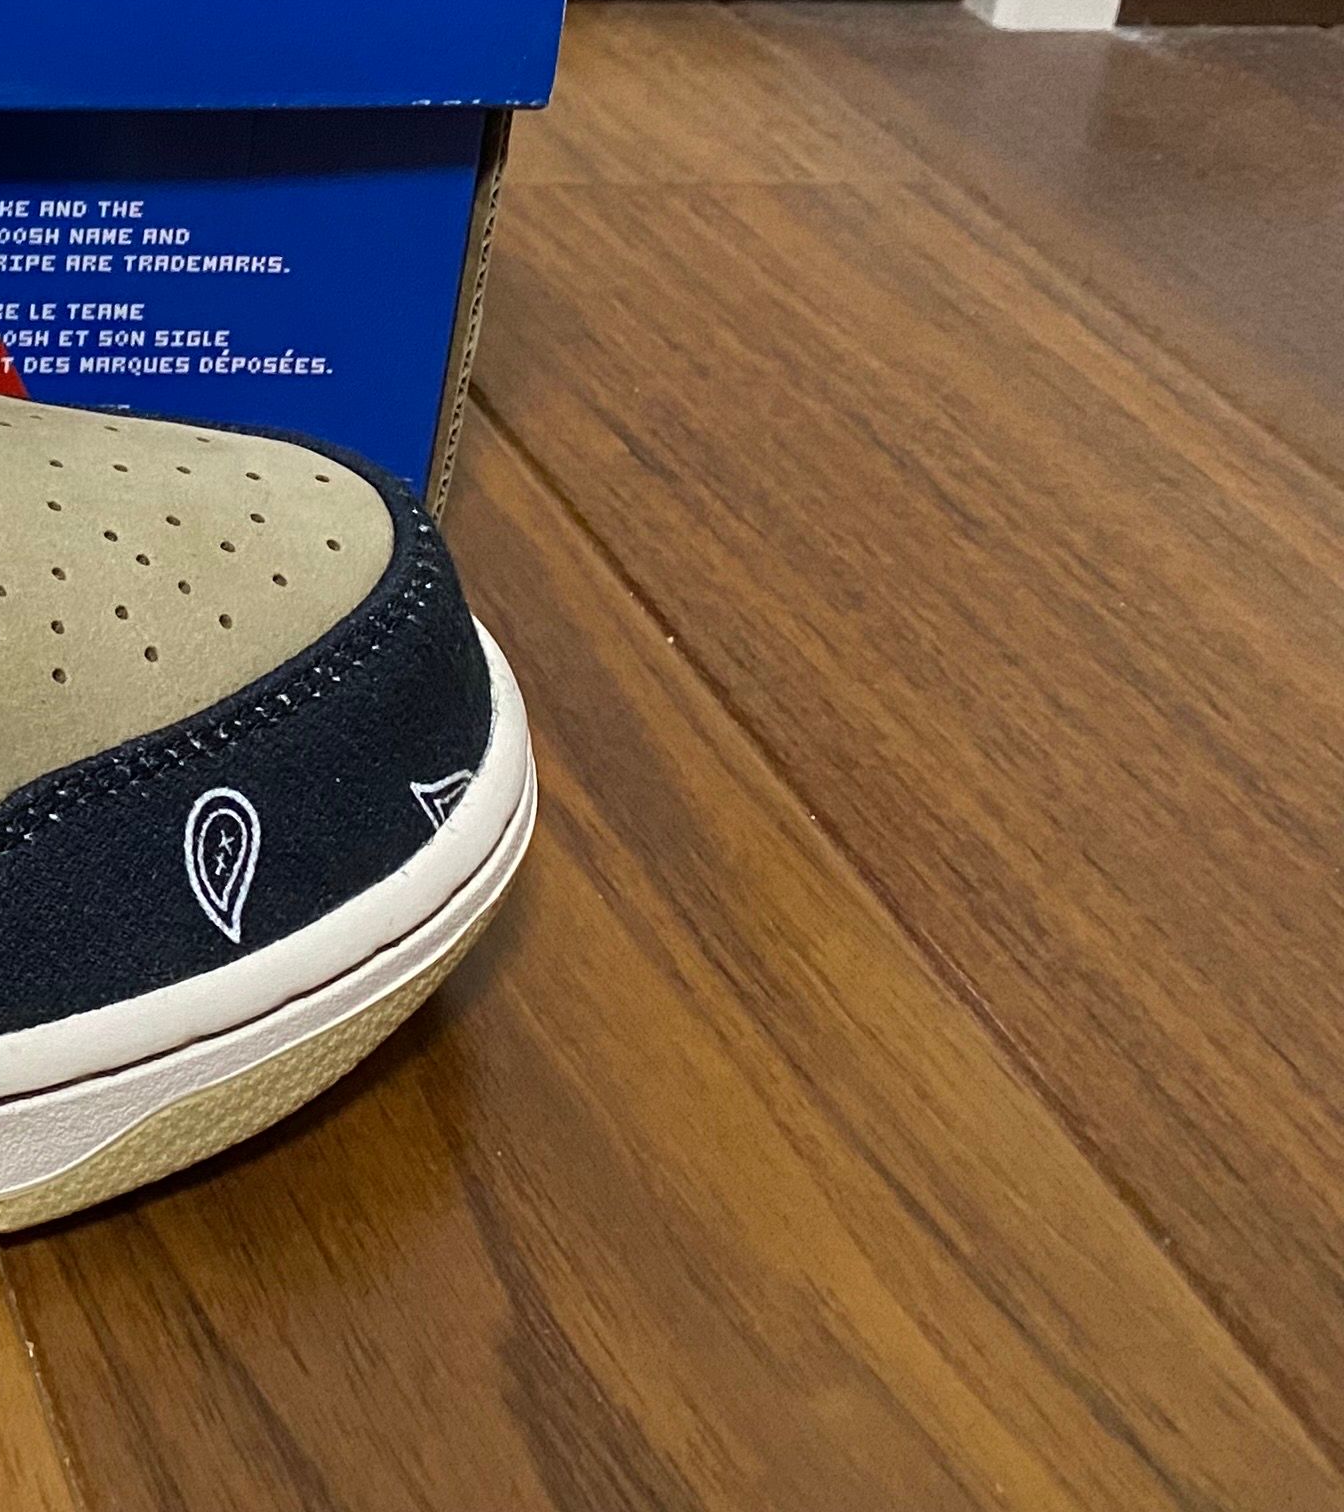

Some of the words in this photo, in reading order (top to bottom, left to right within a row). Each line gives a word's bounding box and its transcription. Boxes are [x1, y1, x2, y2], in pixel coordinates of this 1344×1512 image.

[39, 200, 87, 218] AND
[98, 200, 144, 218] THE
[69, 228, 133, 245] NAME
[142, 228, 190, 245] AND
[65, 254, 113, 273] ARE
[123, 255, 291, 274] TRADEMARKS.
[29, 303, 57, 321] LE
[58, 330, 90, 347] ET
[98, 330, 145, 347] SON
[154, 330, 230, 347] SIGLE
[23, 356, 70, 374] DES
[79, 356, 190, 376] MARQUES
[198, 348, 333, 375] DÉPOSÉES.
